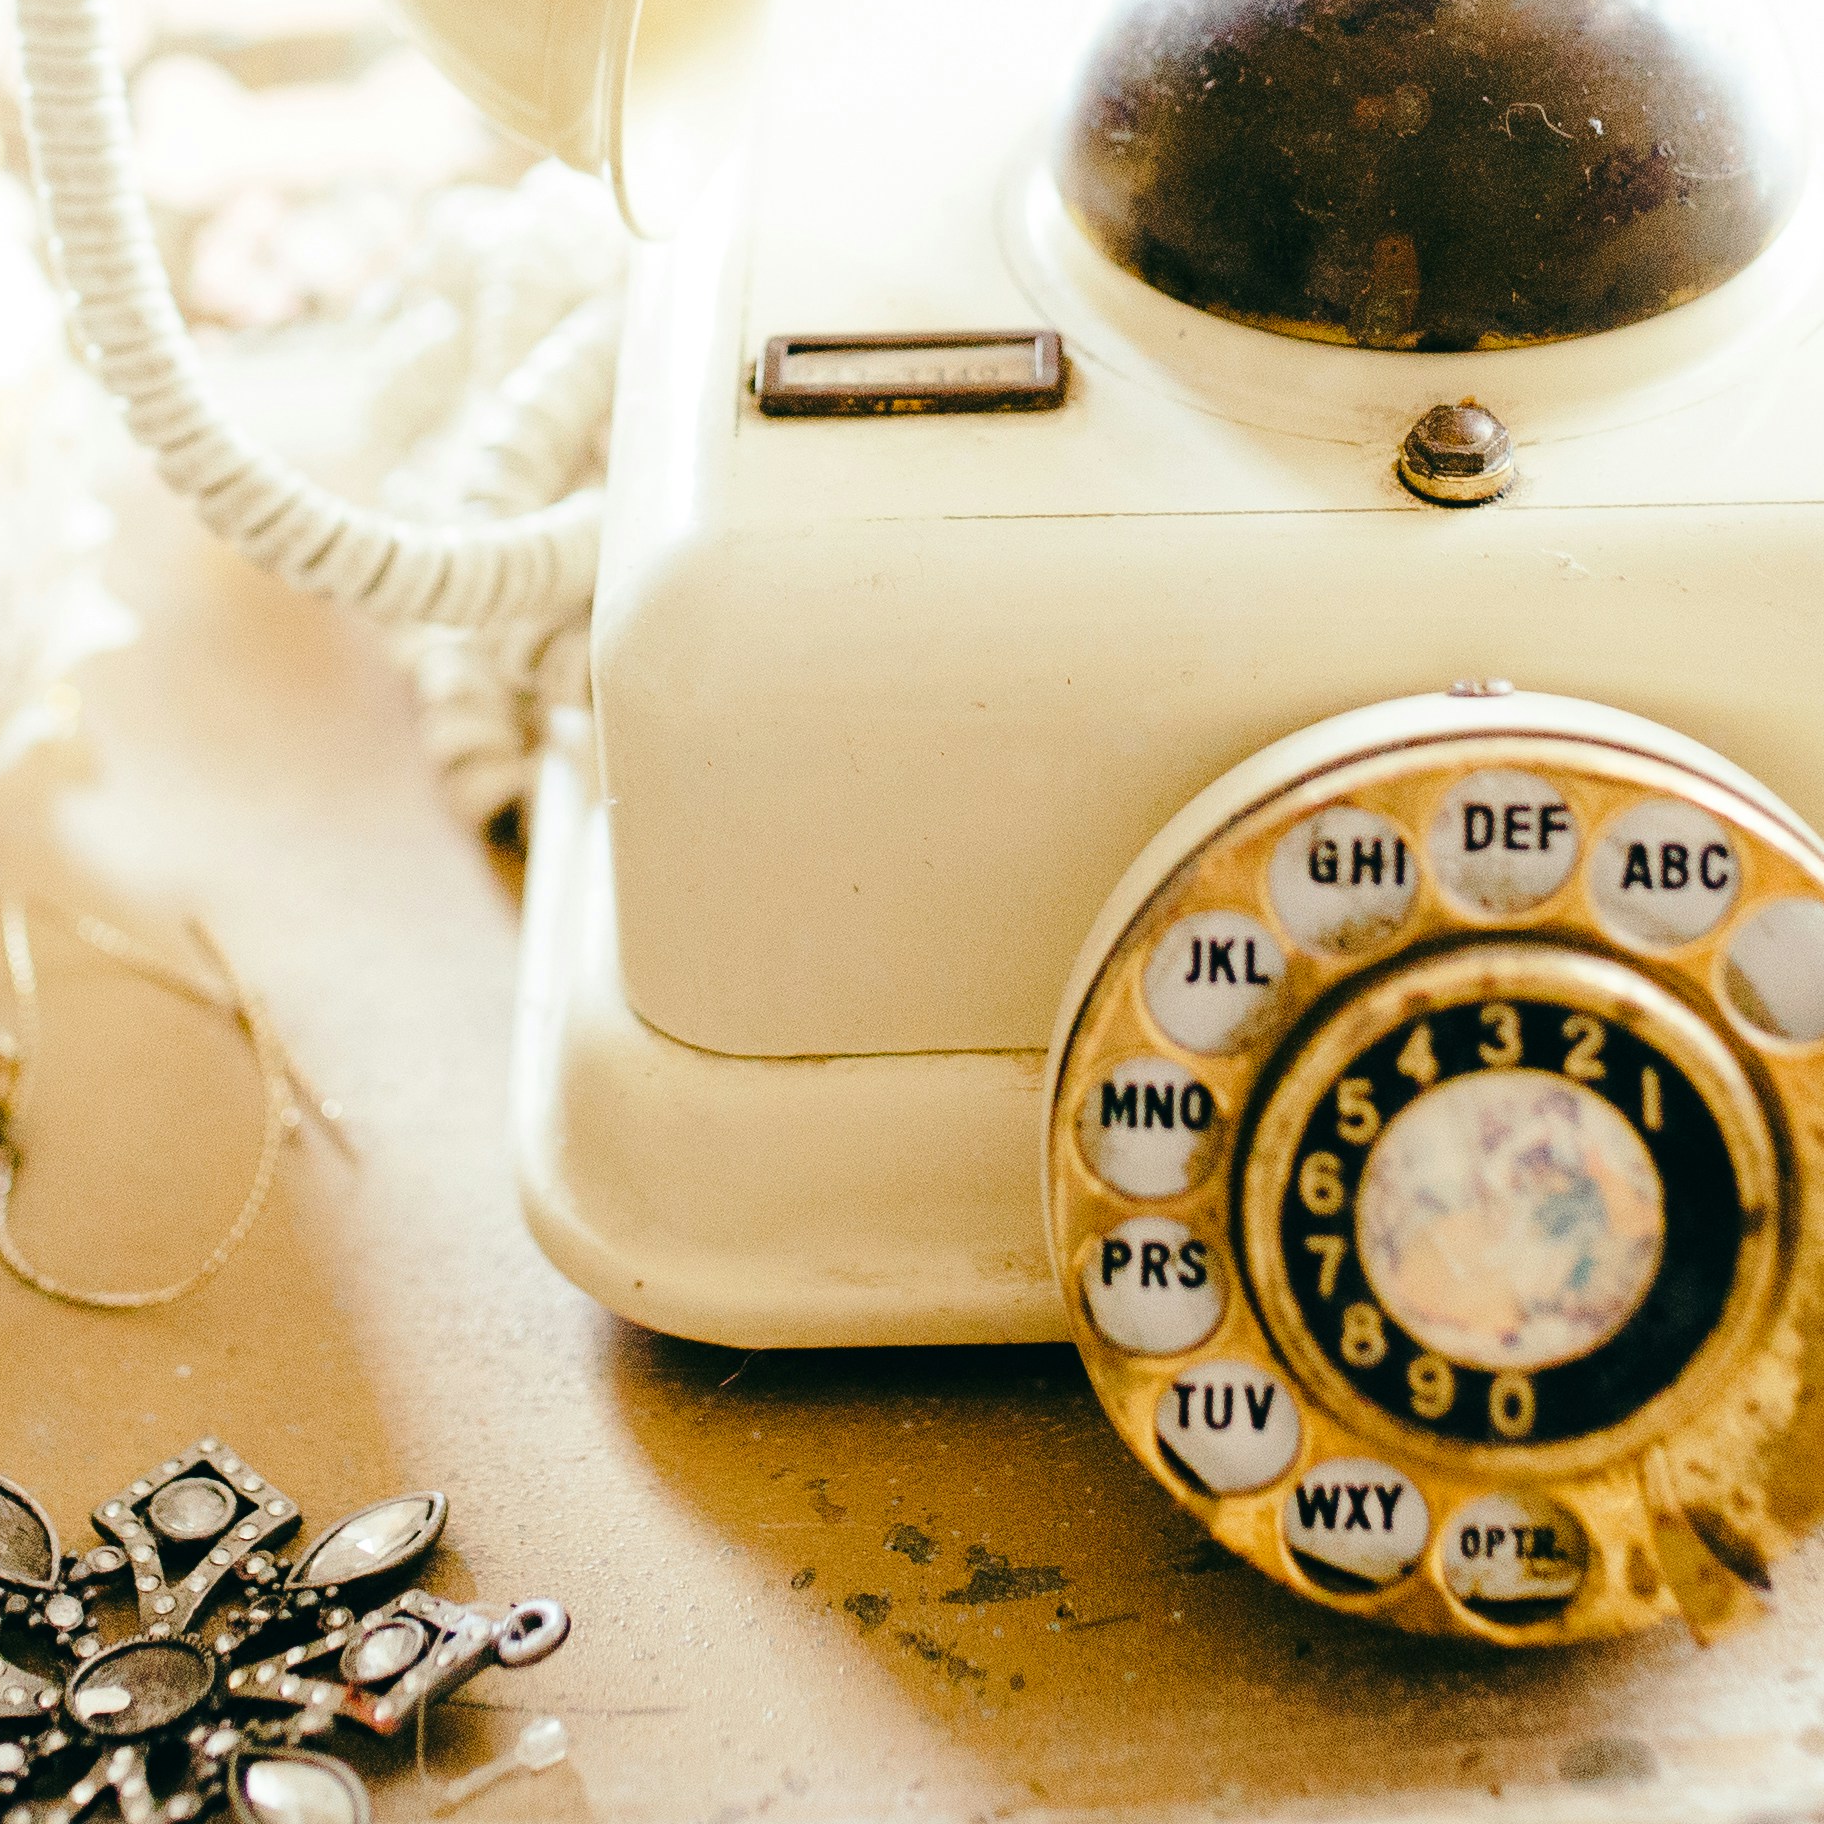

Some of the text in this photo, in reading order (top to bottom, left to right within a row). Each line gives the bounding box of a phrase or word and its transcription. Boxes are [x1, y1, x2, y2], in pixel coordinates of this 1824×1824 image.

[1463, 802, 1568, 853] DEF
[1309, 838, 1406, 885] GHI
[1622, 843, 1729, 890] ABC
[1185, 939, 1270, 985] JKL
[1398, 1027, 1437, 1085] 4
[1481, 1004, 1523, 1068] 3
[1563, 1017, 1606, 1078] 2
[1100, 1081, 1210, 1131] MNO
[1338, 1078, 1379, 1144] 5
[1641, 1066, 1662, 1132] 1
[1300, 1152, 1343, 1214] 6
[1100, 1242, 1207, 1290] PRS
[1304, 1236, 1343, 1298] 7
[1340, 1303, 1387, 1368] 8
[1175, 1383, 1276, 1430] TUV
[1408, 1357, 1454, 1418] 9
[1489, 1374, 1534, 1436] 0
[1296, 1483, 1403, 1531] WXY
